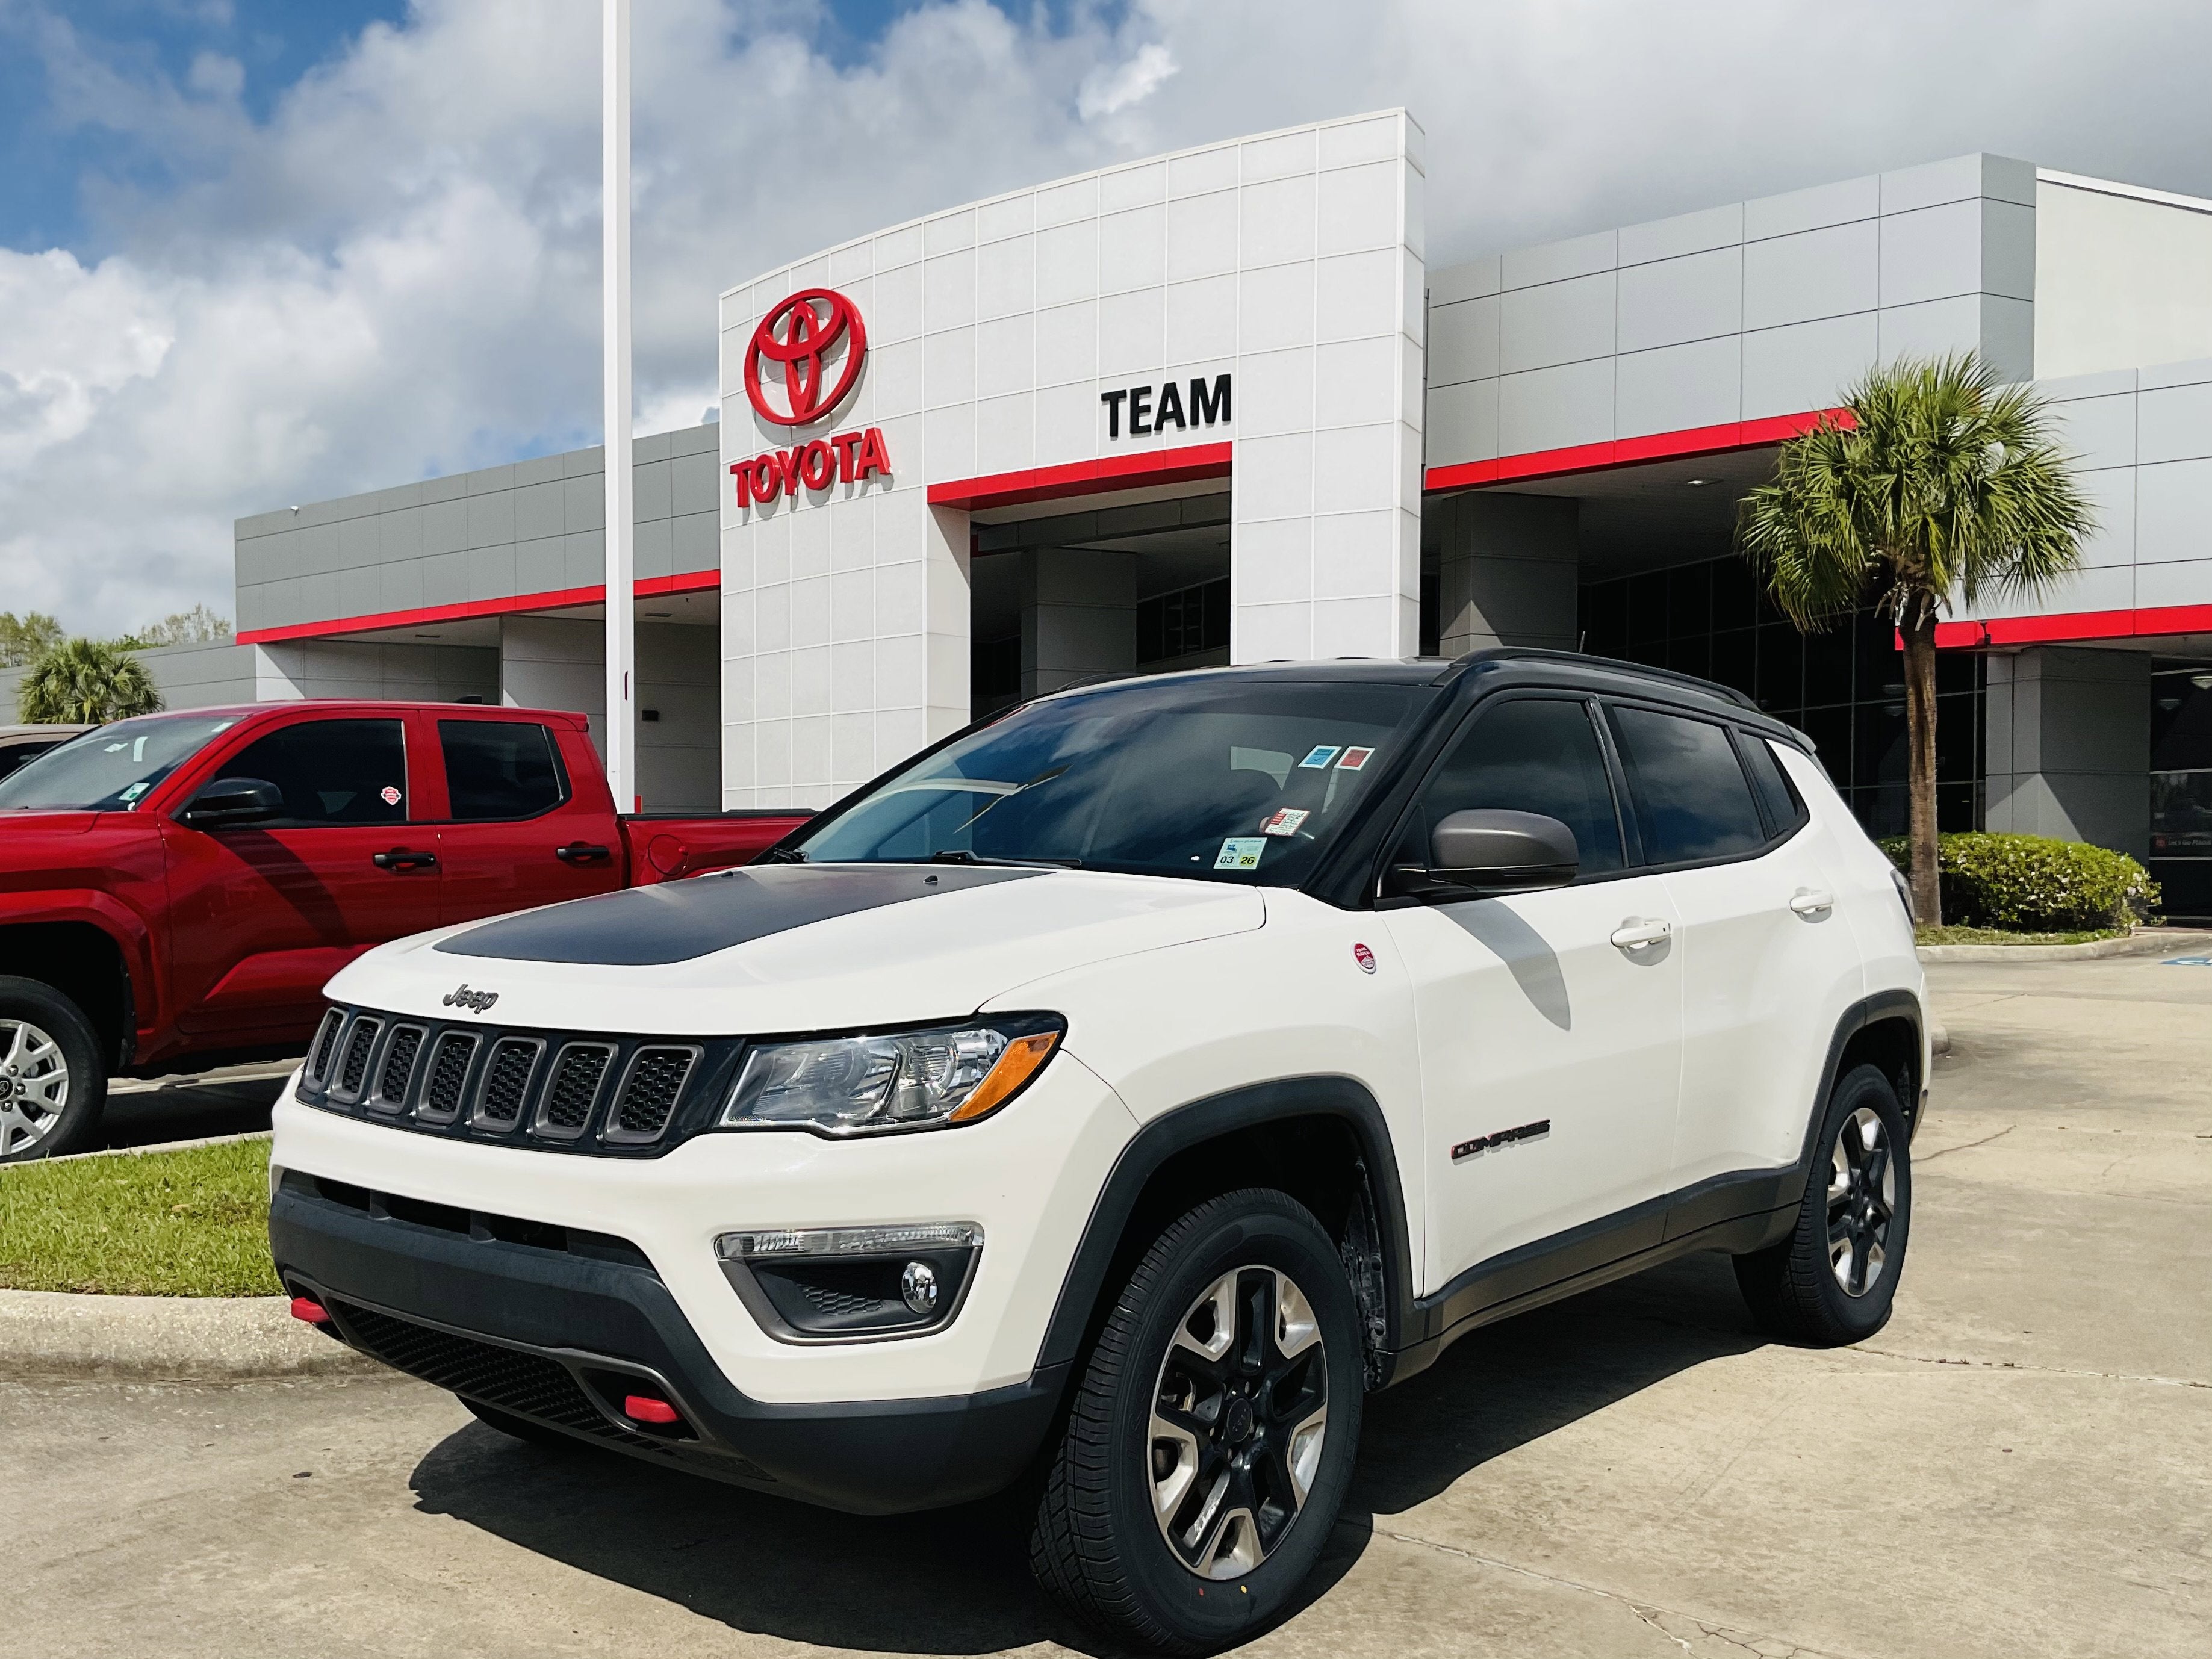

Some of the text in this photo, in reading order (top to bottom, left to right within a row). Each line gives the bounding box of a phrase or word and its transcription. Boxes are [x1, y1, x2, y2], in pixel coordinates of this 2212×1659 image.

[1101, 373, 1231, 437] TEAM
[730, 428, 892, 507] TOYOTA
[443, 984, 499, 1014] Jeep
